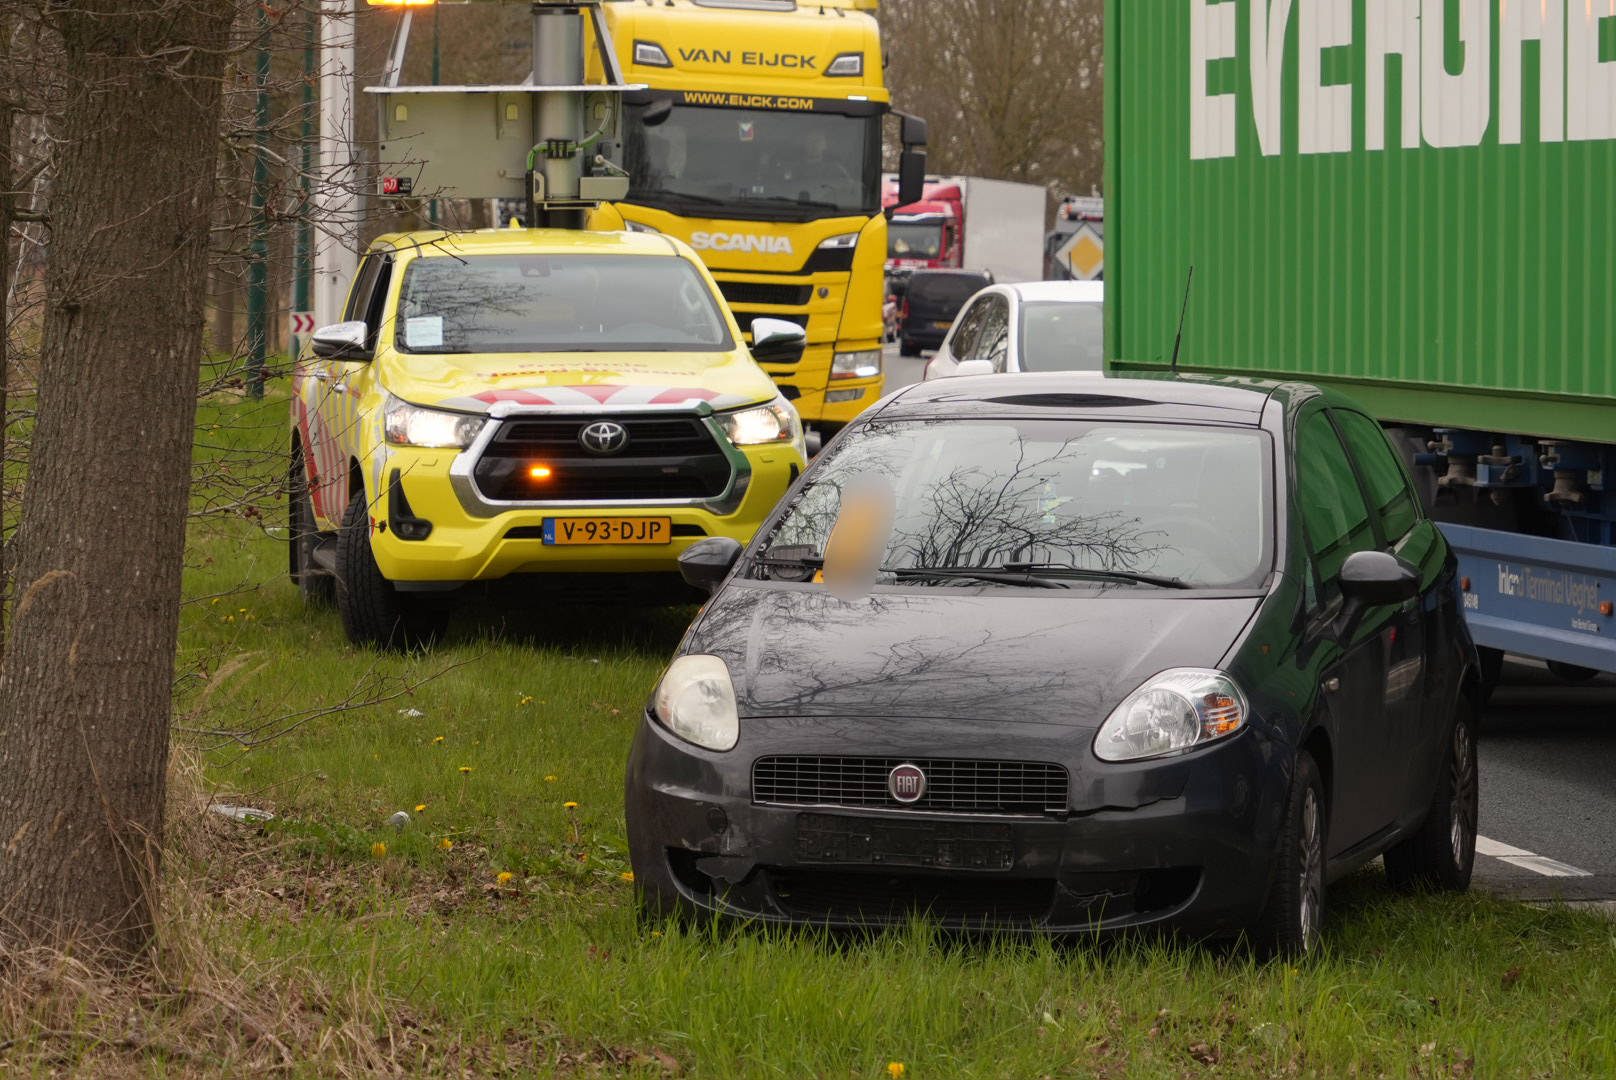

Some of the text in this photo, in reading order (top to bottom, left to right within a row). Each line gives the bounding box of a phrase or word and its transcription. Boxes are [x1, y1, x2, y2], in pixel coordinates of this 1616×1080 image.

[679, 48, 816, 69] VAN EIJCK
[683, 91, 814, 110] WWW.EIJCK.COM
[690, 231, 793, 254] SCANIA
[562, 521, 661, 540] V-93-DJP
[897, 776, 918, 793] FIAT
